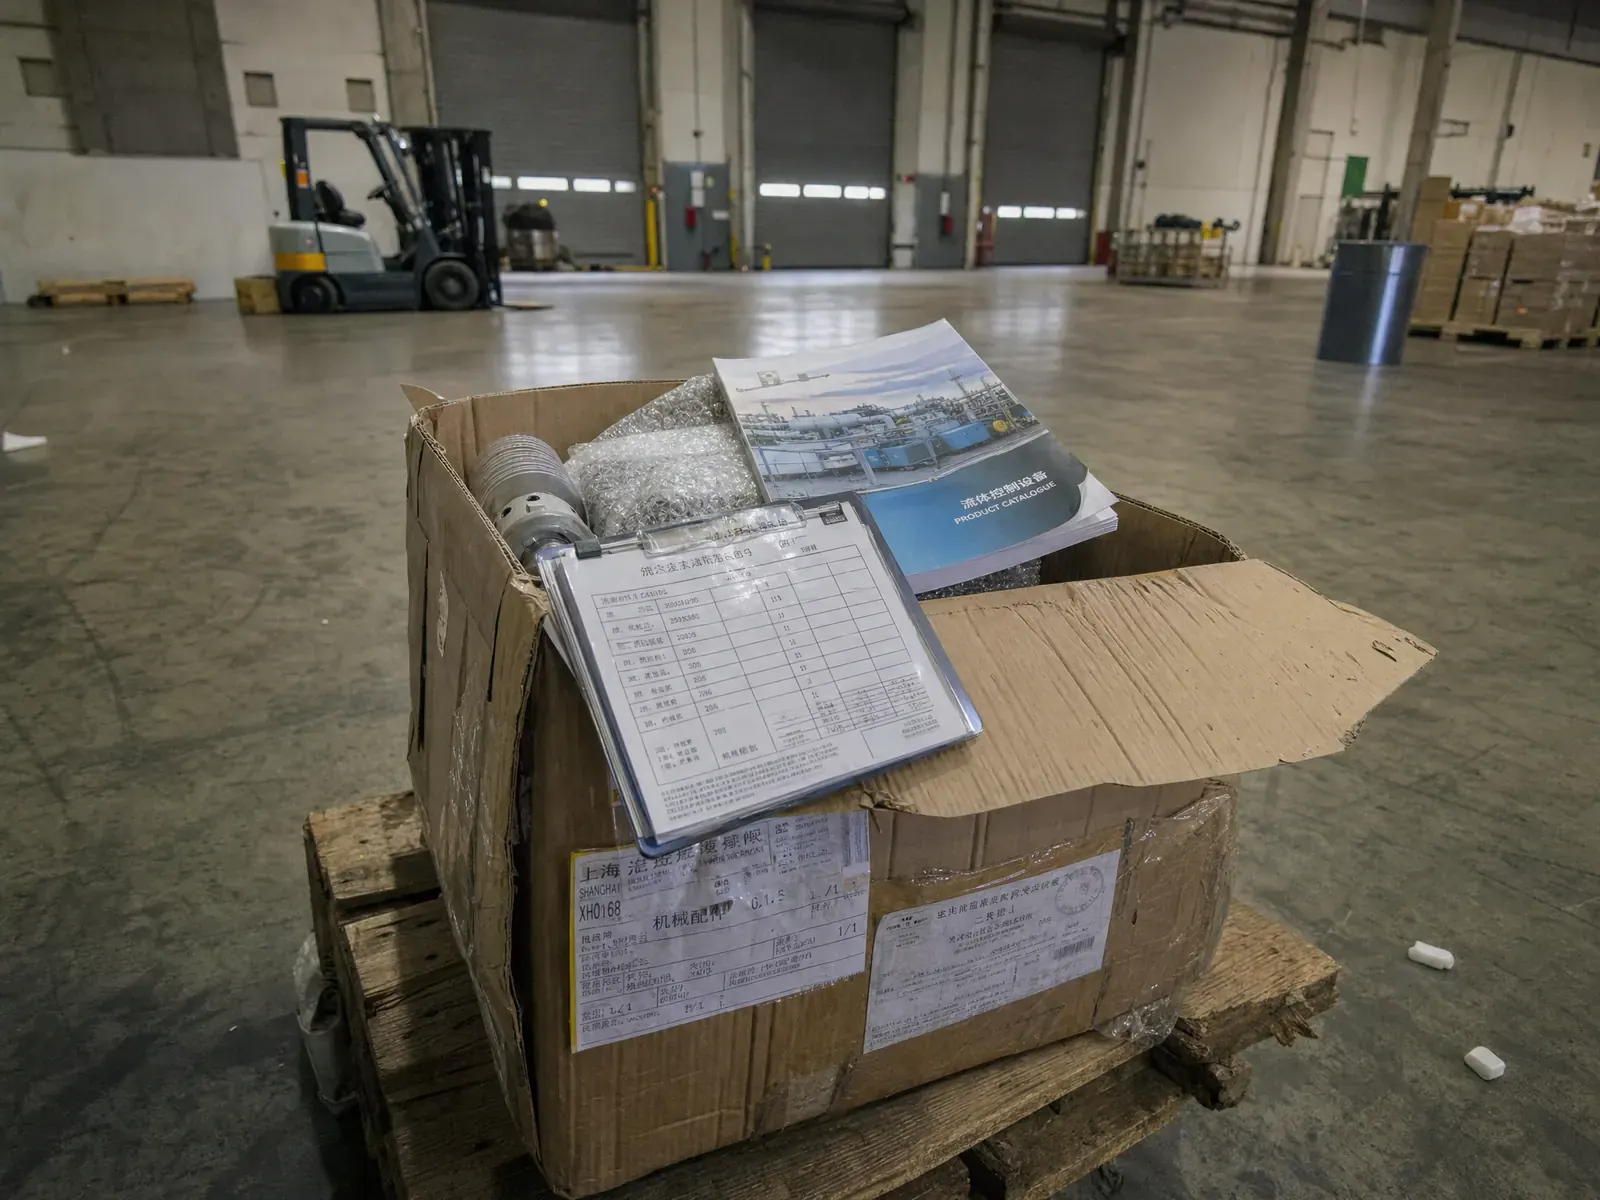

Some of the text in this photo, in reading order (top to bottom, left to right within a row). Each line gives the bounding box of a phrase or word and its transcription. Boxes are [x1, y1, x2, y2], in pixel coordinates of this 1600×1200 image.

[953, 480, 1057, 525] PRODUCT CATALOGUE
[960, 470, 1048, 510] 流体控制设备
[578, 883, 621, 900] SHANGHAI
[578, 899, 622, 923] XH0168
[652, 901, 731, 931] 机械配件
